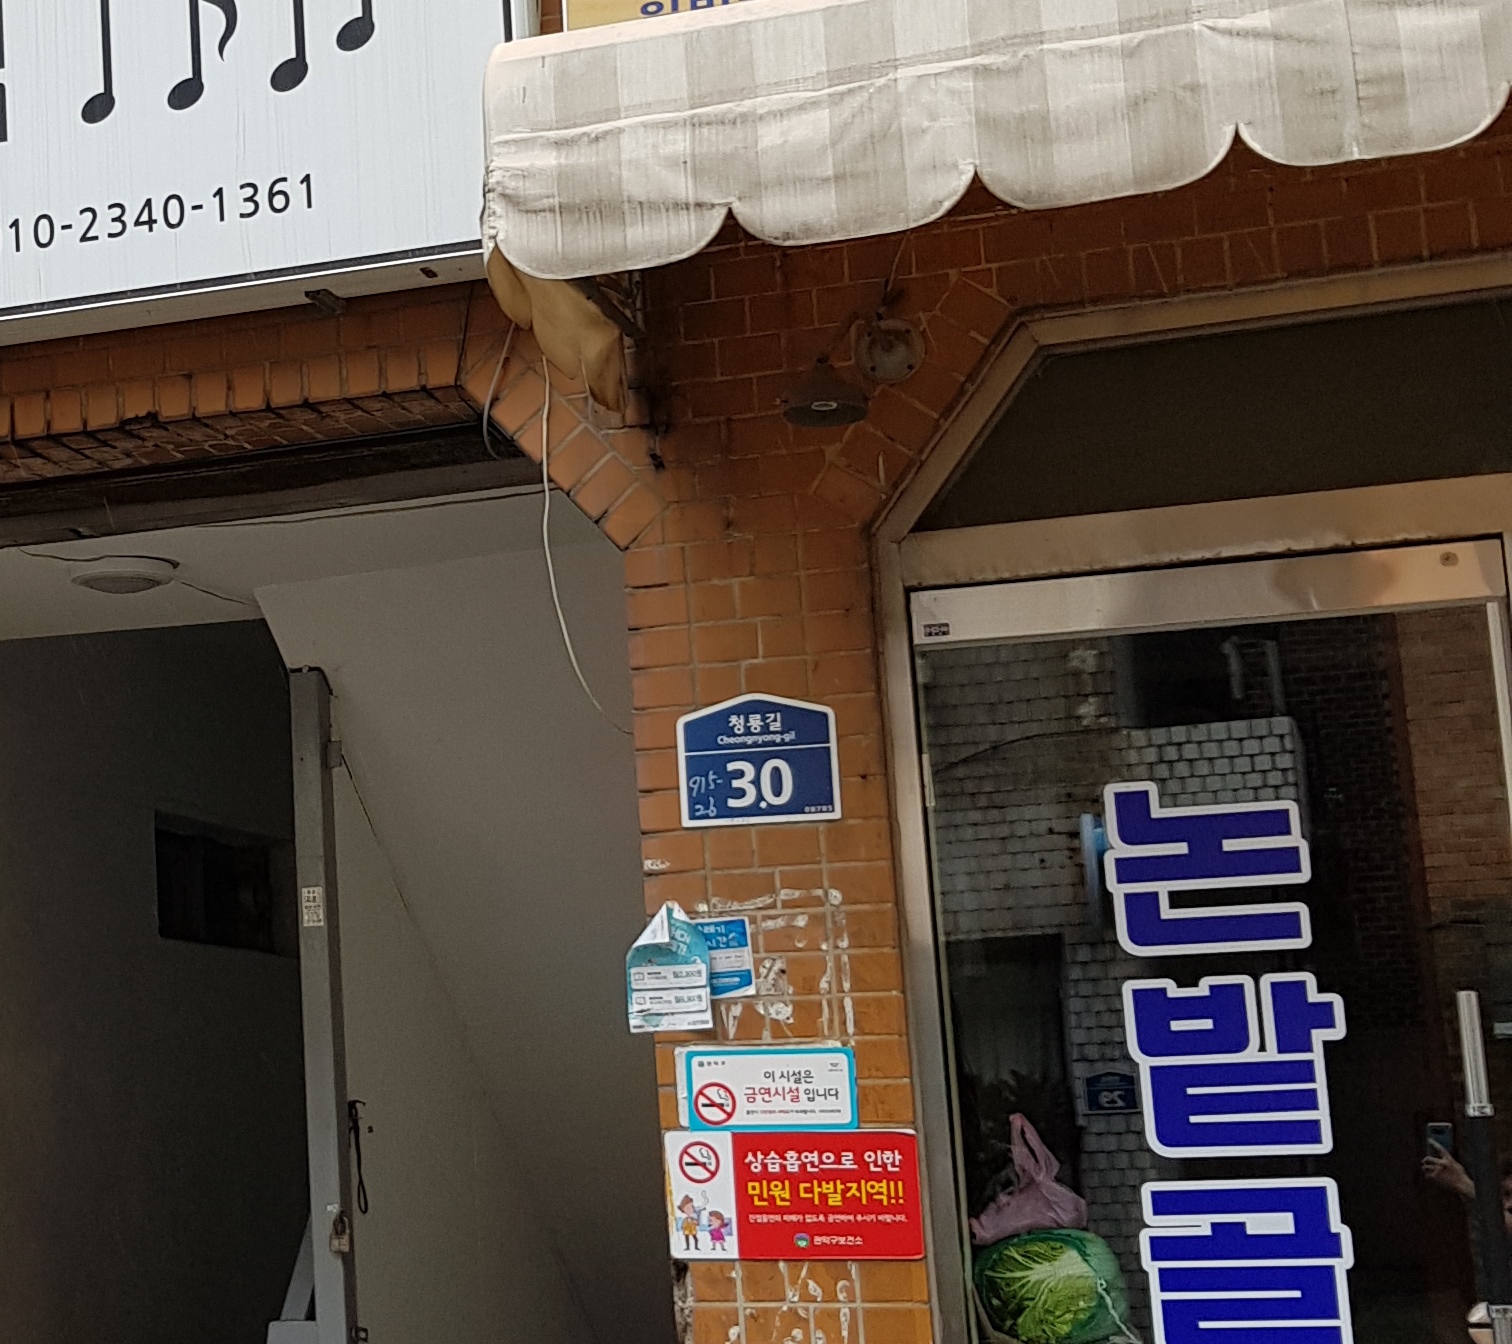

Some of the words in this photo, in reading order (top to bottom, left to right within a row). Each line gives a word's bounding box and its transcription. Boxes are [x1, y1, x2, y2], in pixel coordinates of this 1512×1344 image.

[728, 712, 782, 734] 청룡길
[726, 758, 793, 808] 30
[764, 1070, 775, 1083] 이
[779, 1069, 814, 1084] 시설은
[744, 1086, 800, 1104] 금연시설
[804, 1087, 839, 1102] 입니다
[744, 1150, 858, 1173] 상습흡연으로
[864, 1150, 901, 1172] 인한
[747, 1179, 791, 1206] 민원
[799, 1178, 904, 1205] 다발지역!!
